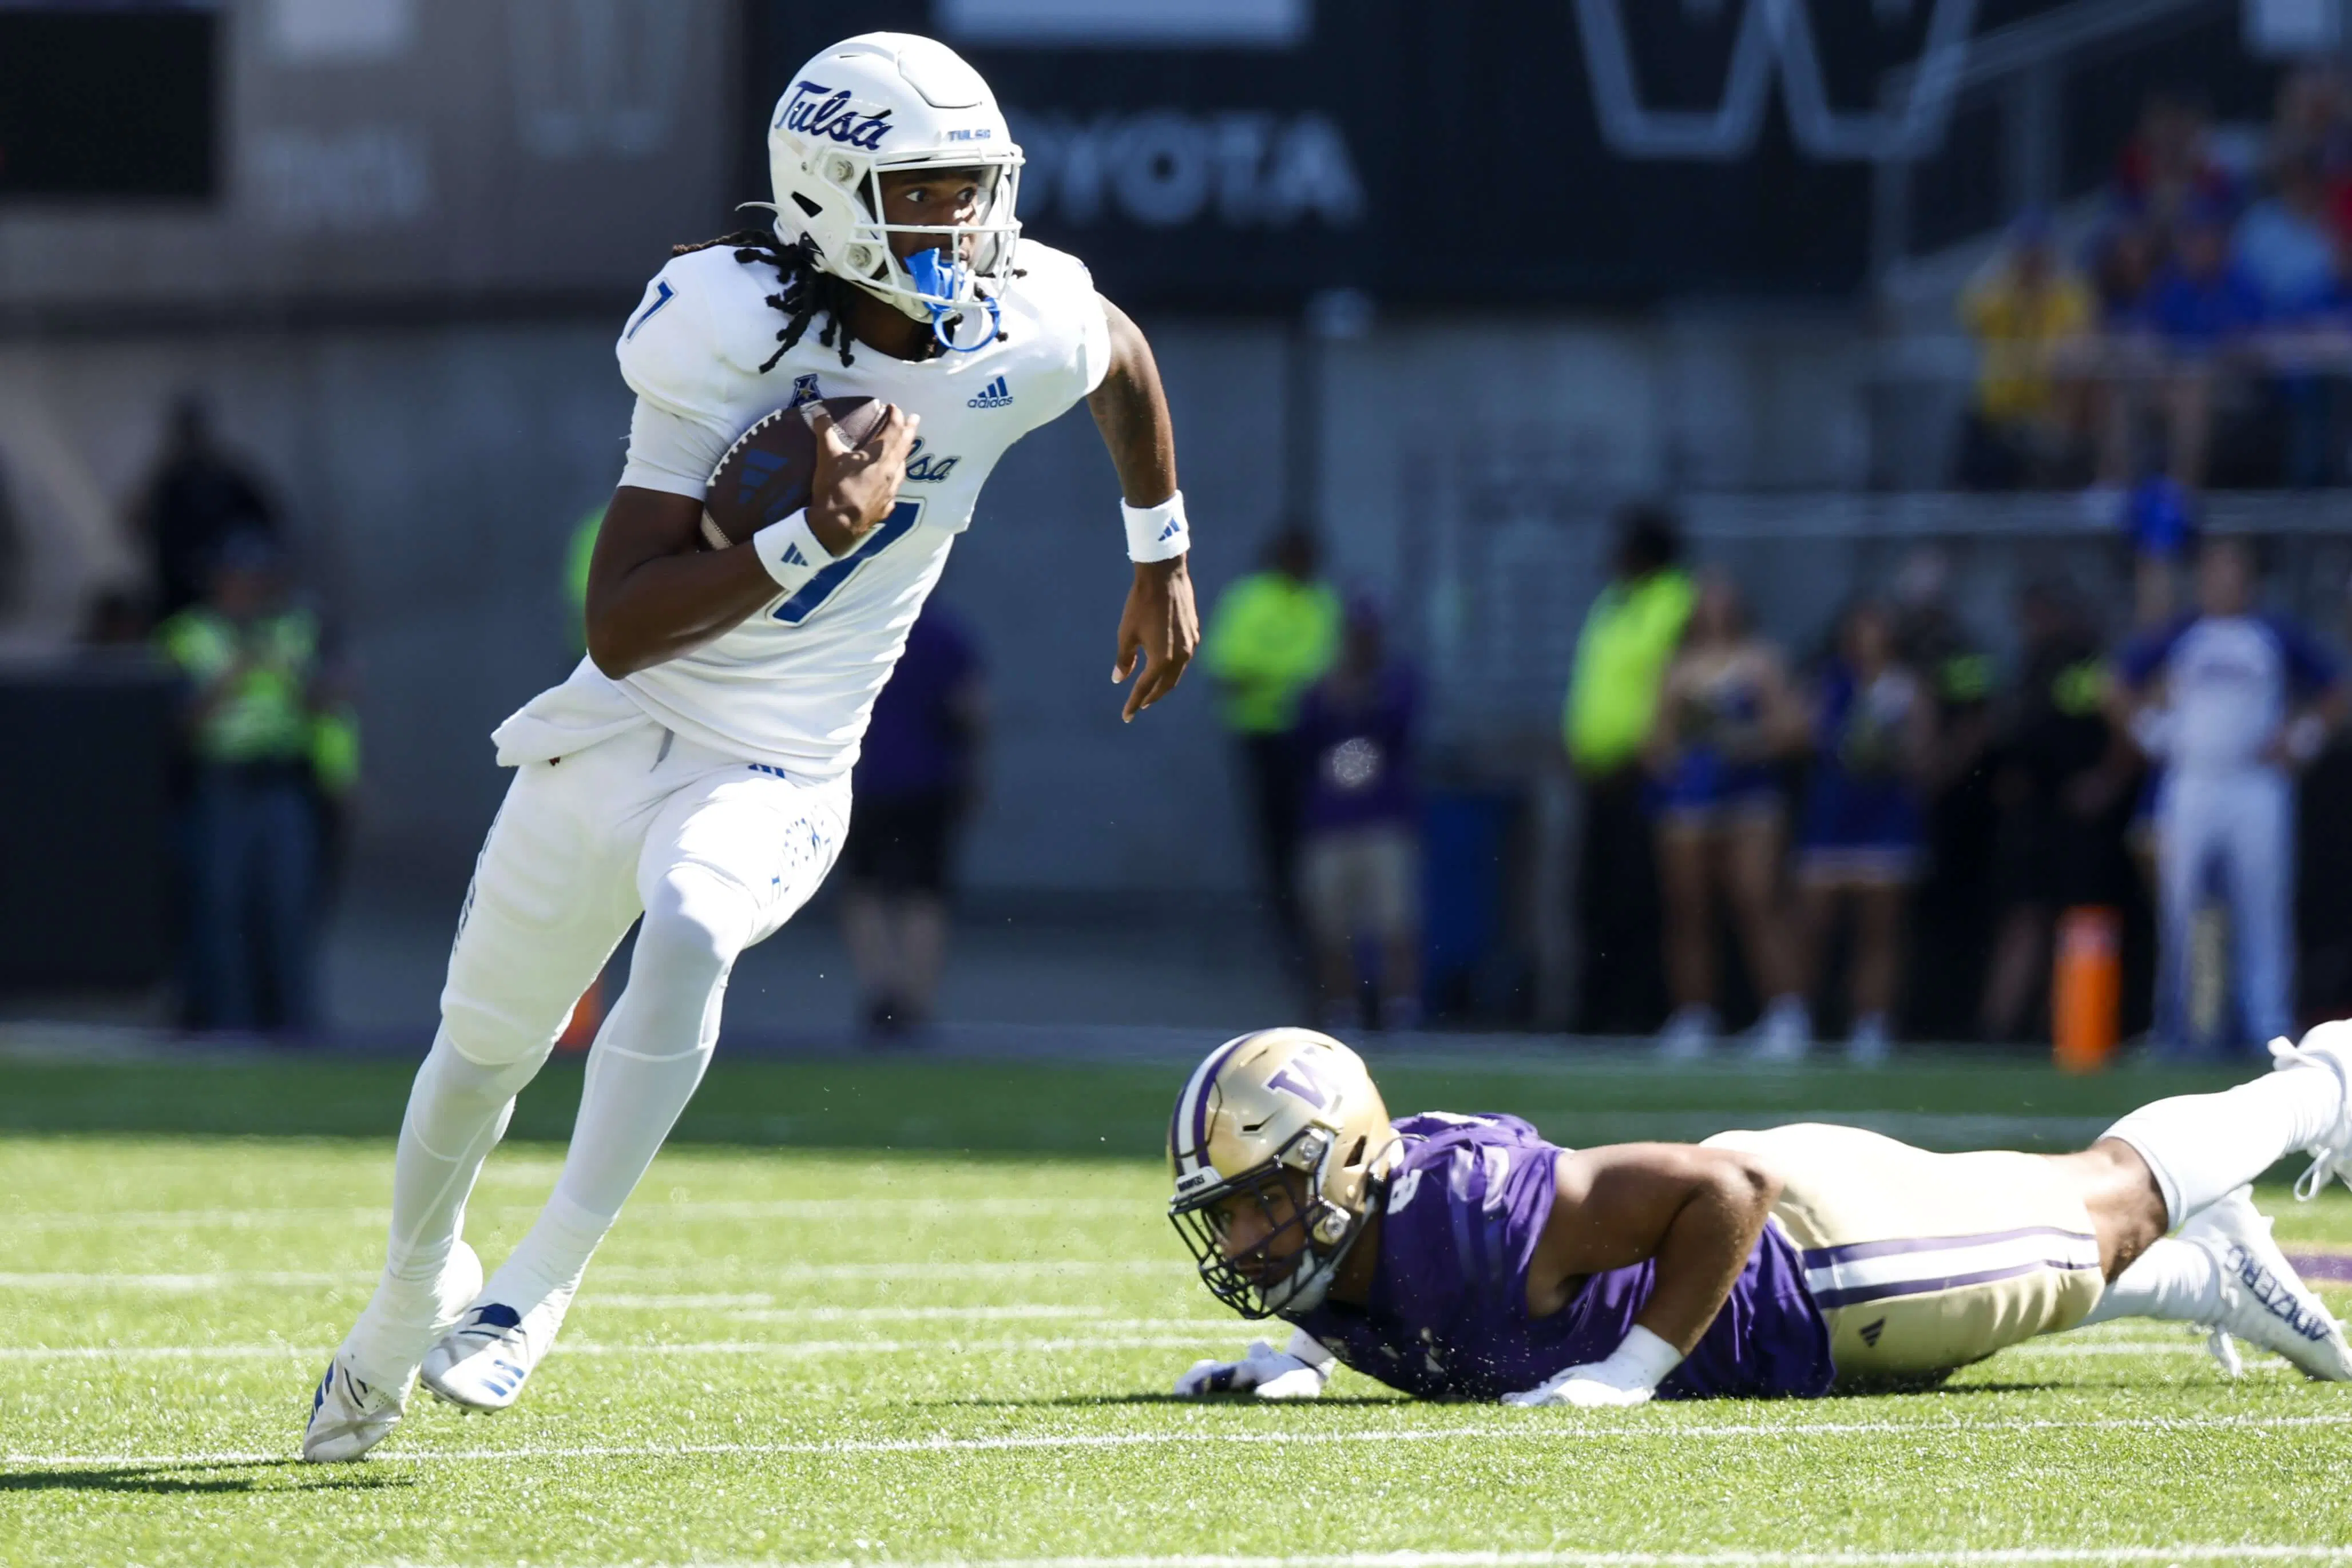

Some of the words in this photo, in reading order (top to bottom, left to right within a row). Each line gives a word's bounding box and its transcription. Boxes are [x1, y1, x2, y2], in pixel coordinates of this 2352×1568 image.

[774, 80, 894, 150] Tulsa
[1010, 109, 1367, 223] YOTA
[967, 394, 1013, 408] adidas
[906, 438, 960, 482] lsa
